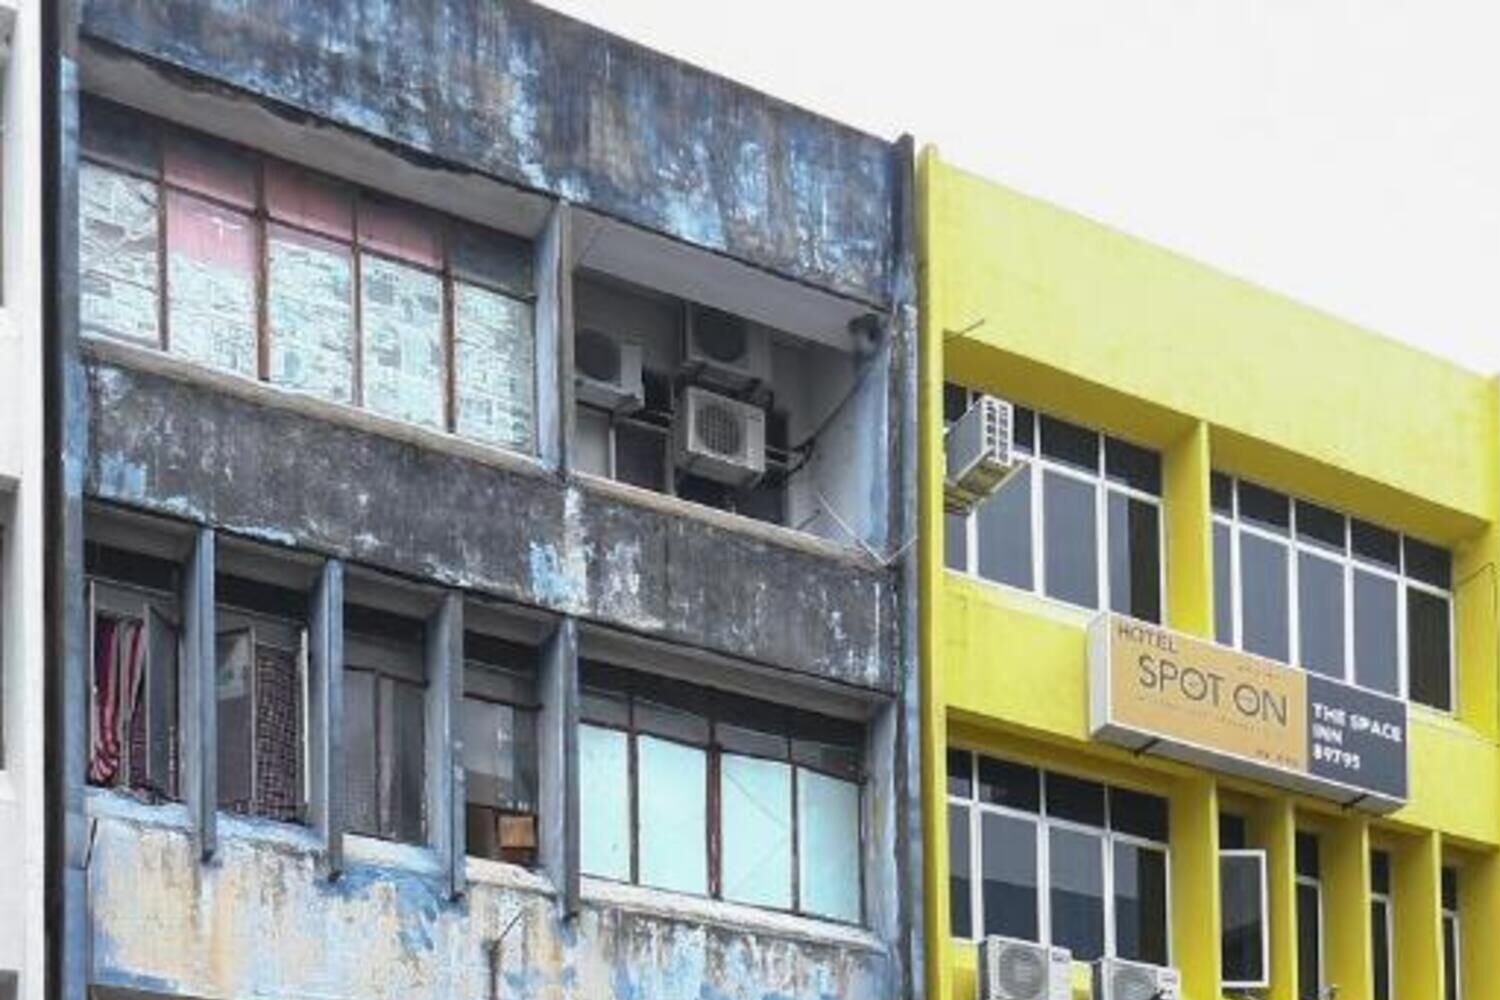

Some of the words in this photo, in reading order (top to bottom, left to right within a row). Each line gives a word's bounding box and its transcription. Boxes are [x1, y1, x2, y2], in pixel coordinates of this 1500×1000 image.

[1118, 621, 1178, 655] HOTEL
[1138, 655, 1225, 708] SPOT
[1233, 683, 1287, 727] ON
[1311, 702, 1346, 728] THE
[1349, 713, 1402, 743] SPACE
[1312, 724, 1343, 746] INN
